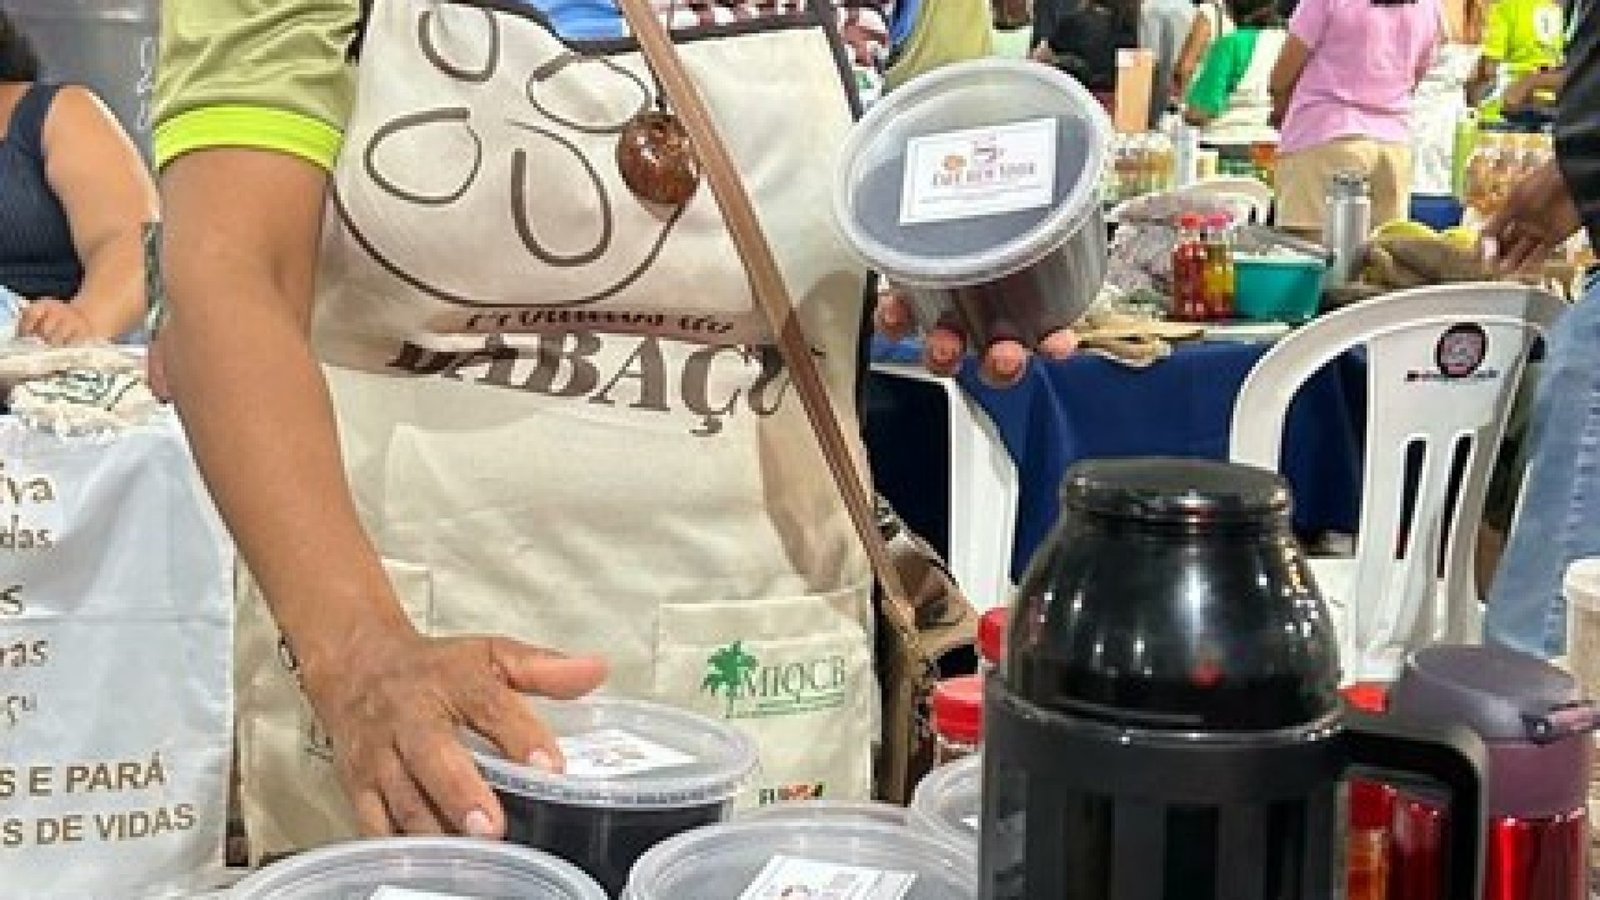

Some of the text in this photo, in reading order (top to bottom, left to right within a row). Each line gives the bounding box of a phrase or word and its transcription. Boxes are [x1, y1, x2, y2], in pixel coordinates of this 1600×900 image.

[739, 655, 846, 703] MIQCB
[29, 766, 53, 796] E
[65, 750, 167, 793] PARÁ
[3, 803, 198, 848] S DE VIDAS
